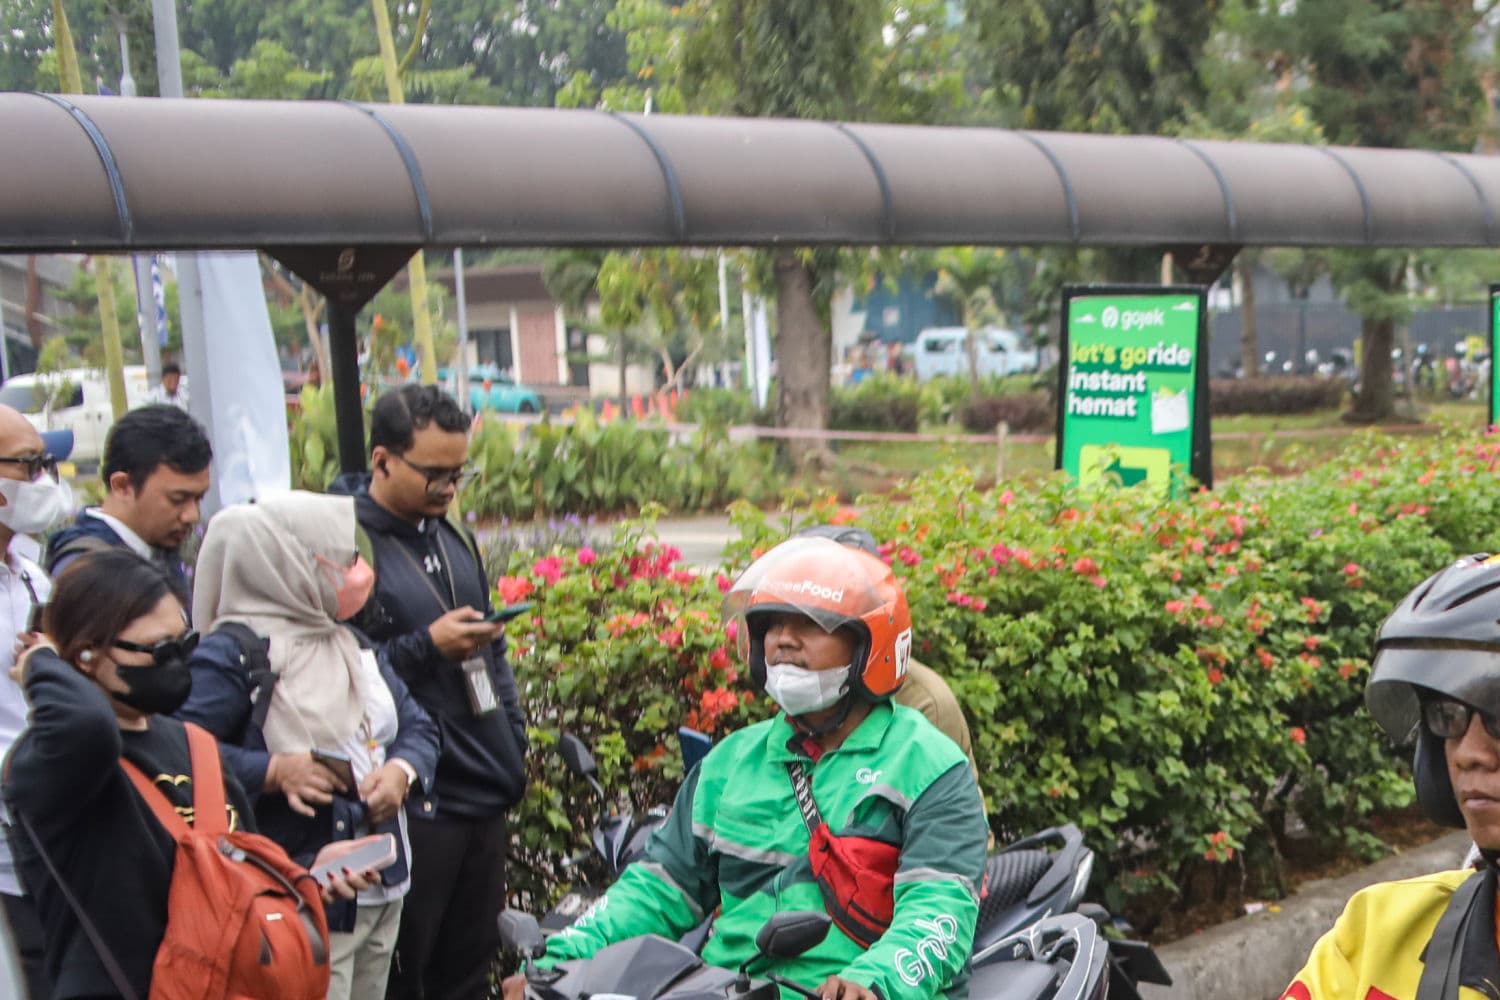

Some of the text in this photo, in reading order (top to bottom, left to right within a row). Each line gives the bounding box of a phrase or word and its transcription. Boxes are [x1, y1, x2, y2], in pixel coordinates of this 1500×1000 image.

[1121, 307, 1164, 331] gojek
[1071, 340, 1116, 365] let's
[1069, 365, 1146, 393] instant
[1068, 392, 1138, 418] hemat
